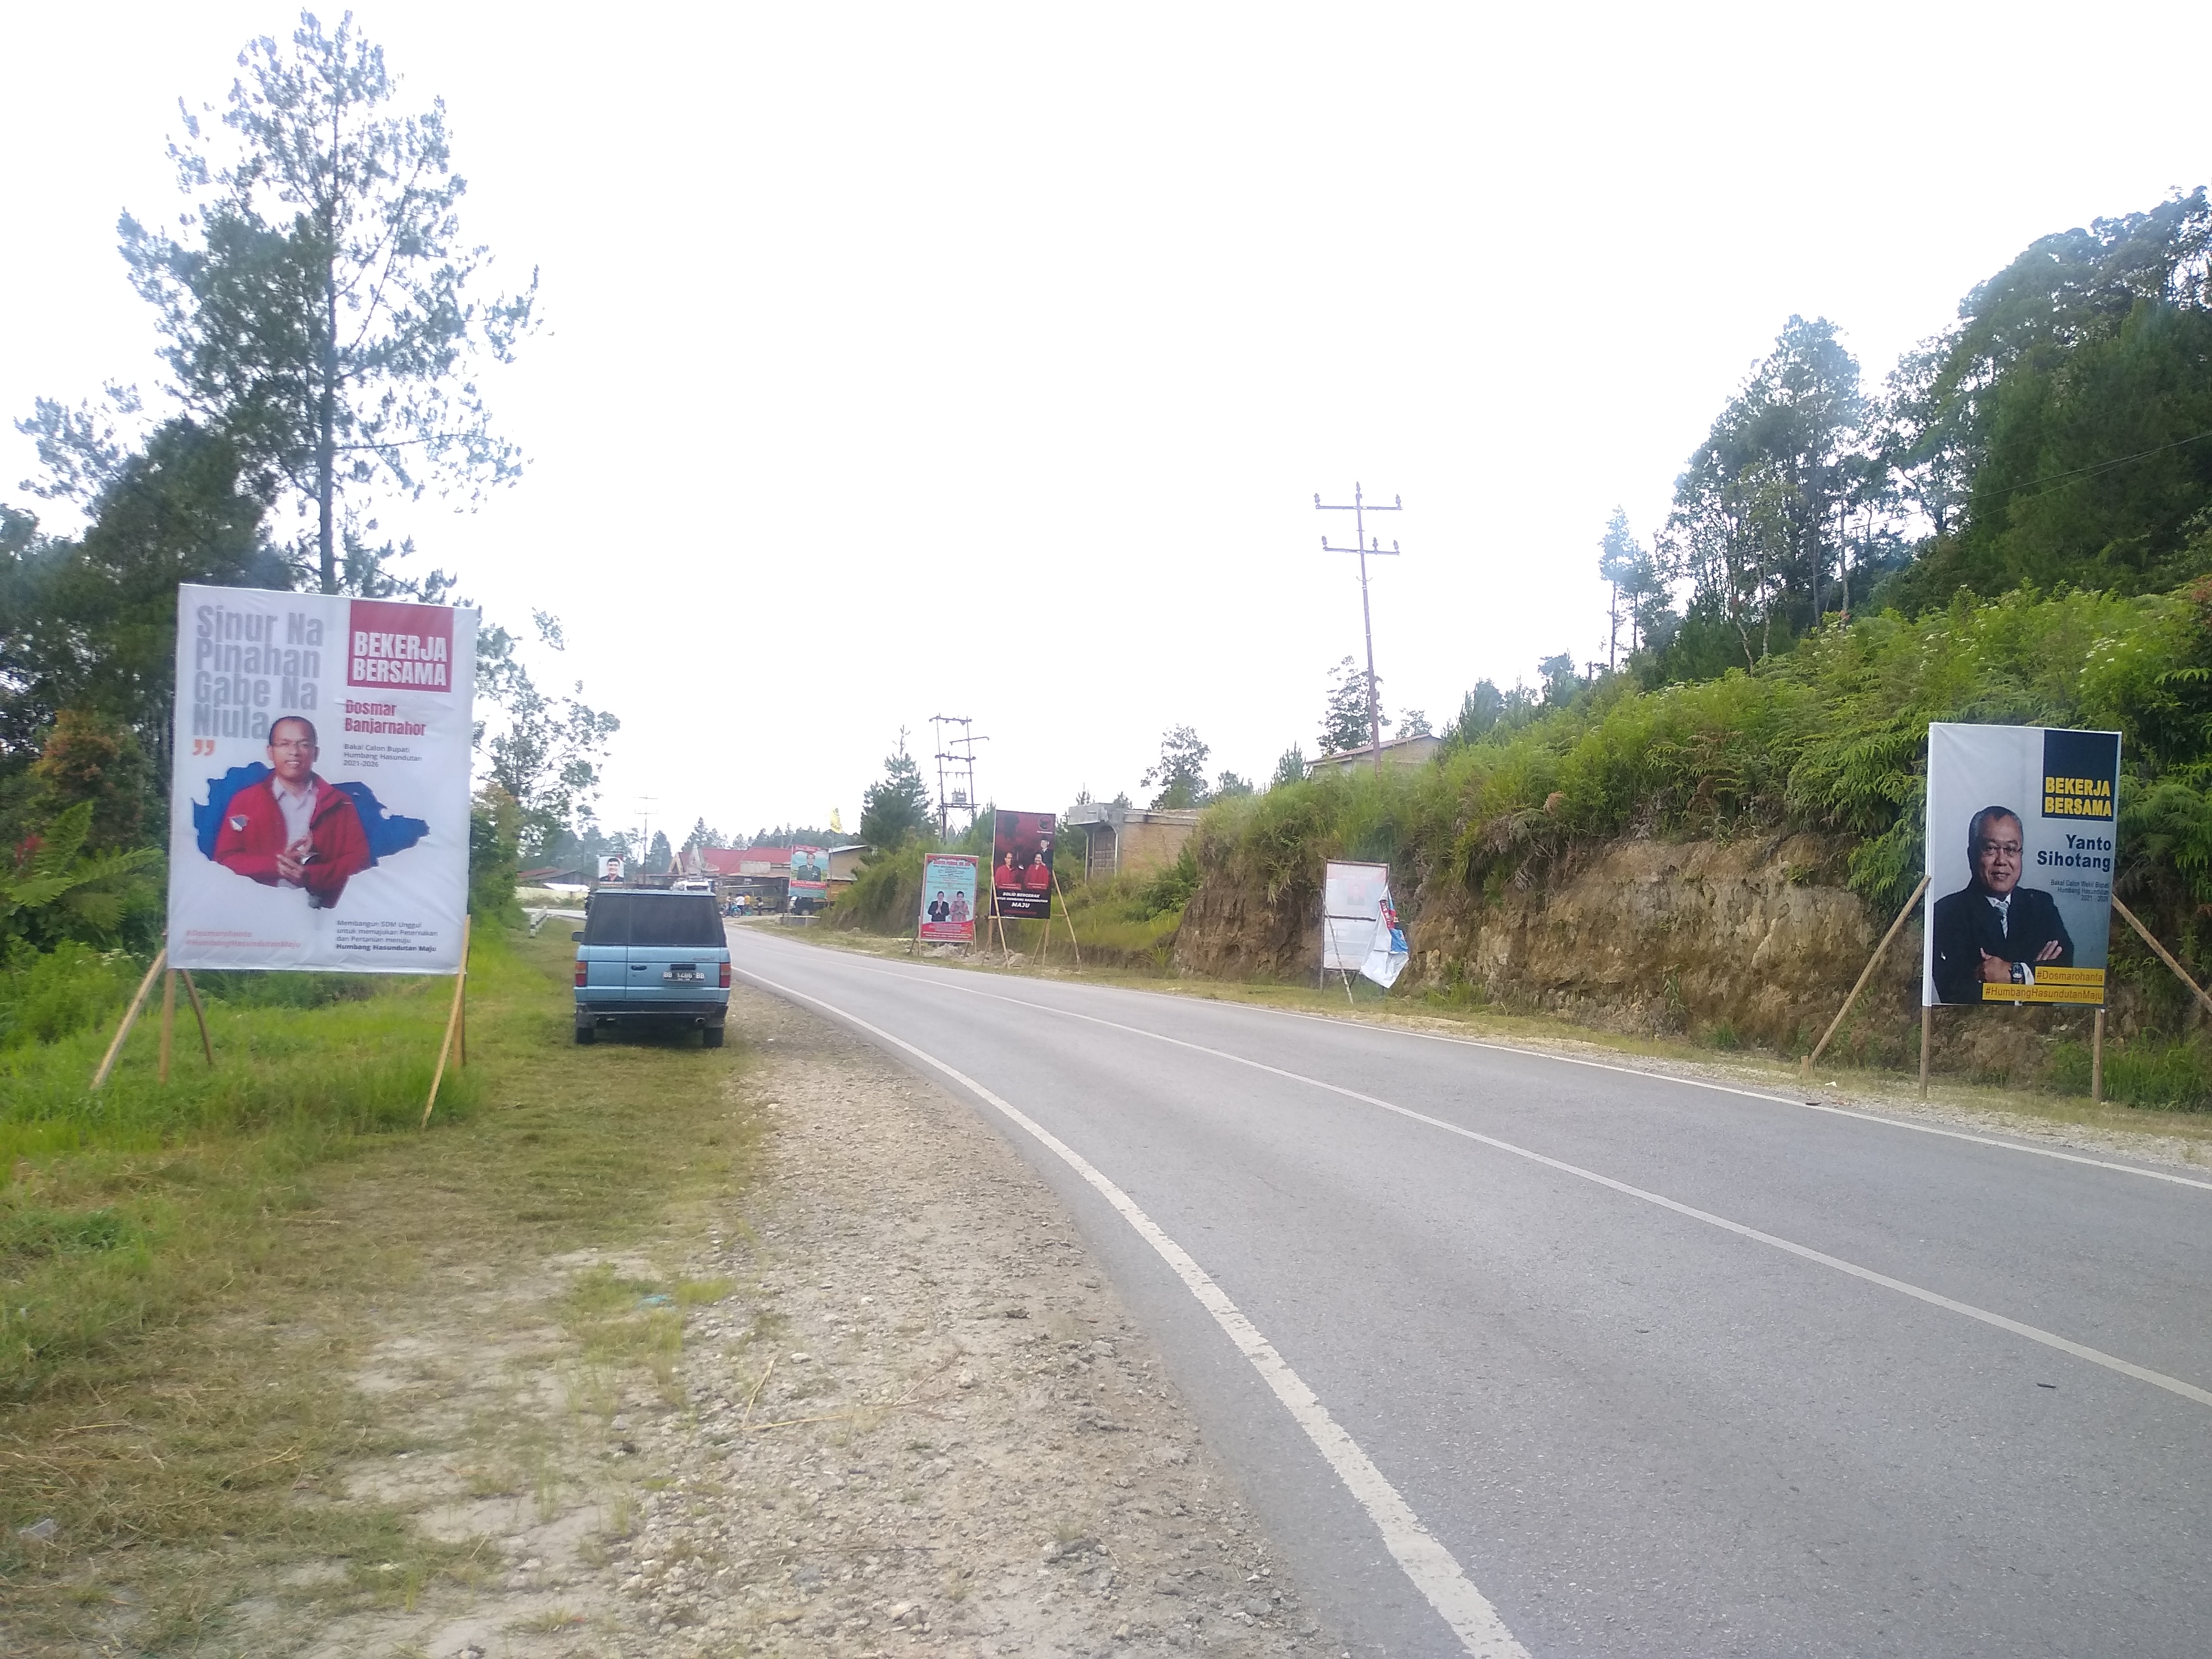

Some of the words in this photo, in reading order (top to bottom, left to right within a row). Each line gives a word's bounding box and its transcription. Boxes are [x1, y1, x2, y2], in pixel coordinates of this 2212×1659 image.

[197, 605, 278, 643] Sinur
[288, 612, 324, 646] Na
[354, 631, 447, 662] BEKERJA
[196, 638, 321, 679] Pinahan
[353, 658, 447, 686] BERSAMA
[195, 670, 271, 708] Gabe
[282, 676, 318, 711] Na
[346, 699, 397, 717] Dosmar
[194, 703, 269, 740] Niula
[345, 717, 426, 736] Banjarnahor
[344, 752, 378, 760] Humbang
[2045, 776, 2111, 797] BEKERJA
[2044, 796, 2112, 817] BERSAMA
[2065, 834, 2111, 851] Yanto
[2037, 850, 2111, 873] Sihotang
[2036, 970, 2103, 982] #Dosmarohanta
[1985, 986, 2103, 1002] #HumbangHasundutanMaju
